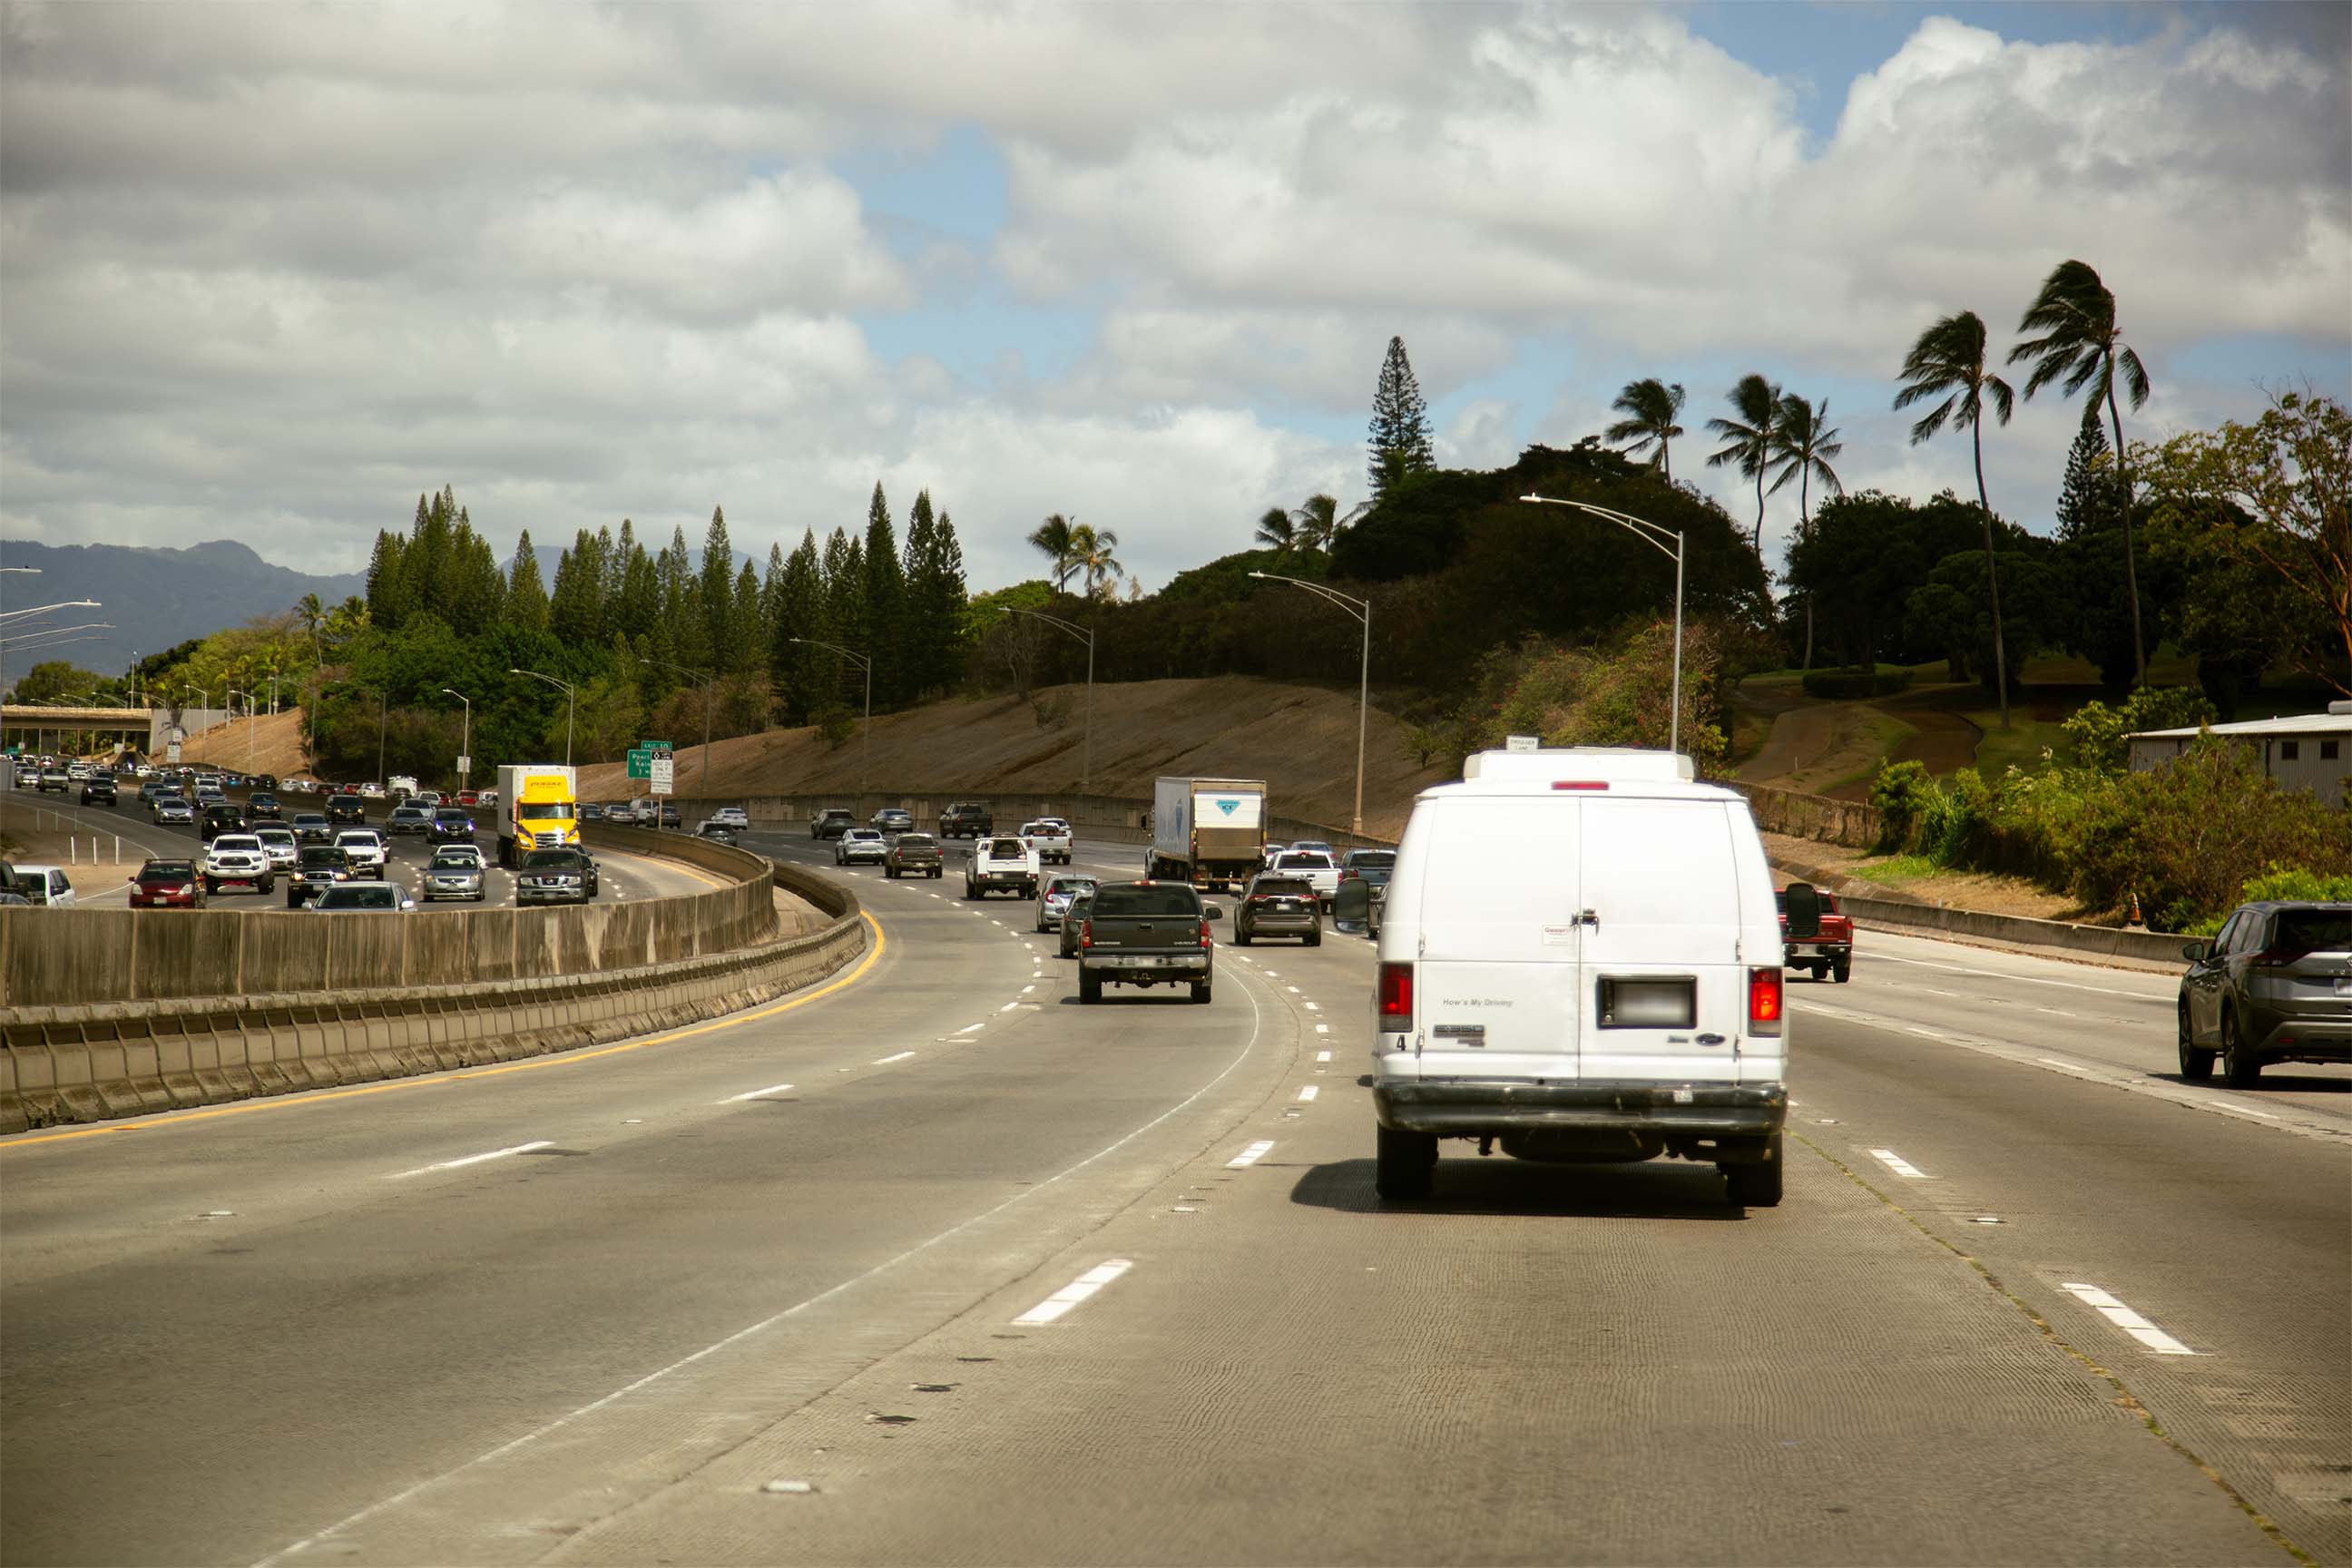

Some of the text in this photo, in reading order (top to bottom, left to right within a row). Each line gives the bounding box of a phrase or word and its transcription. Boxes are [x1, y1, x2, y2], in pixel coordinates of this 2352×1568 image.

[1443, 998, 1468, 1006] How's
[1470, 998, 1483, 1007] My
[1396, 1034, 1406, 1051] 4
